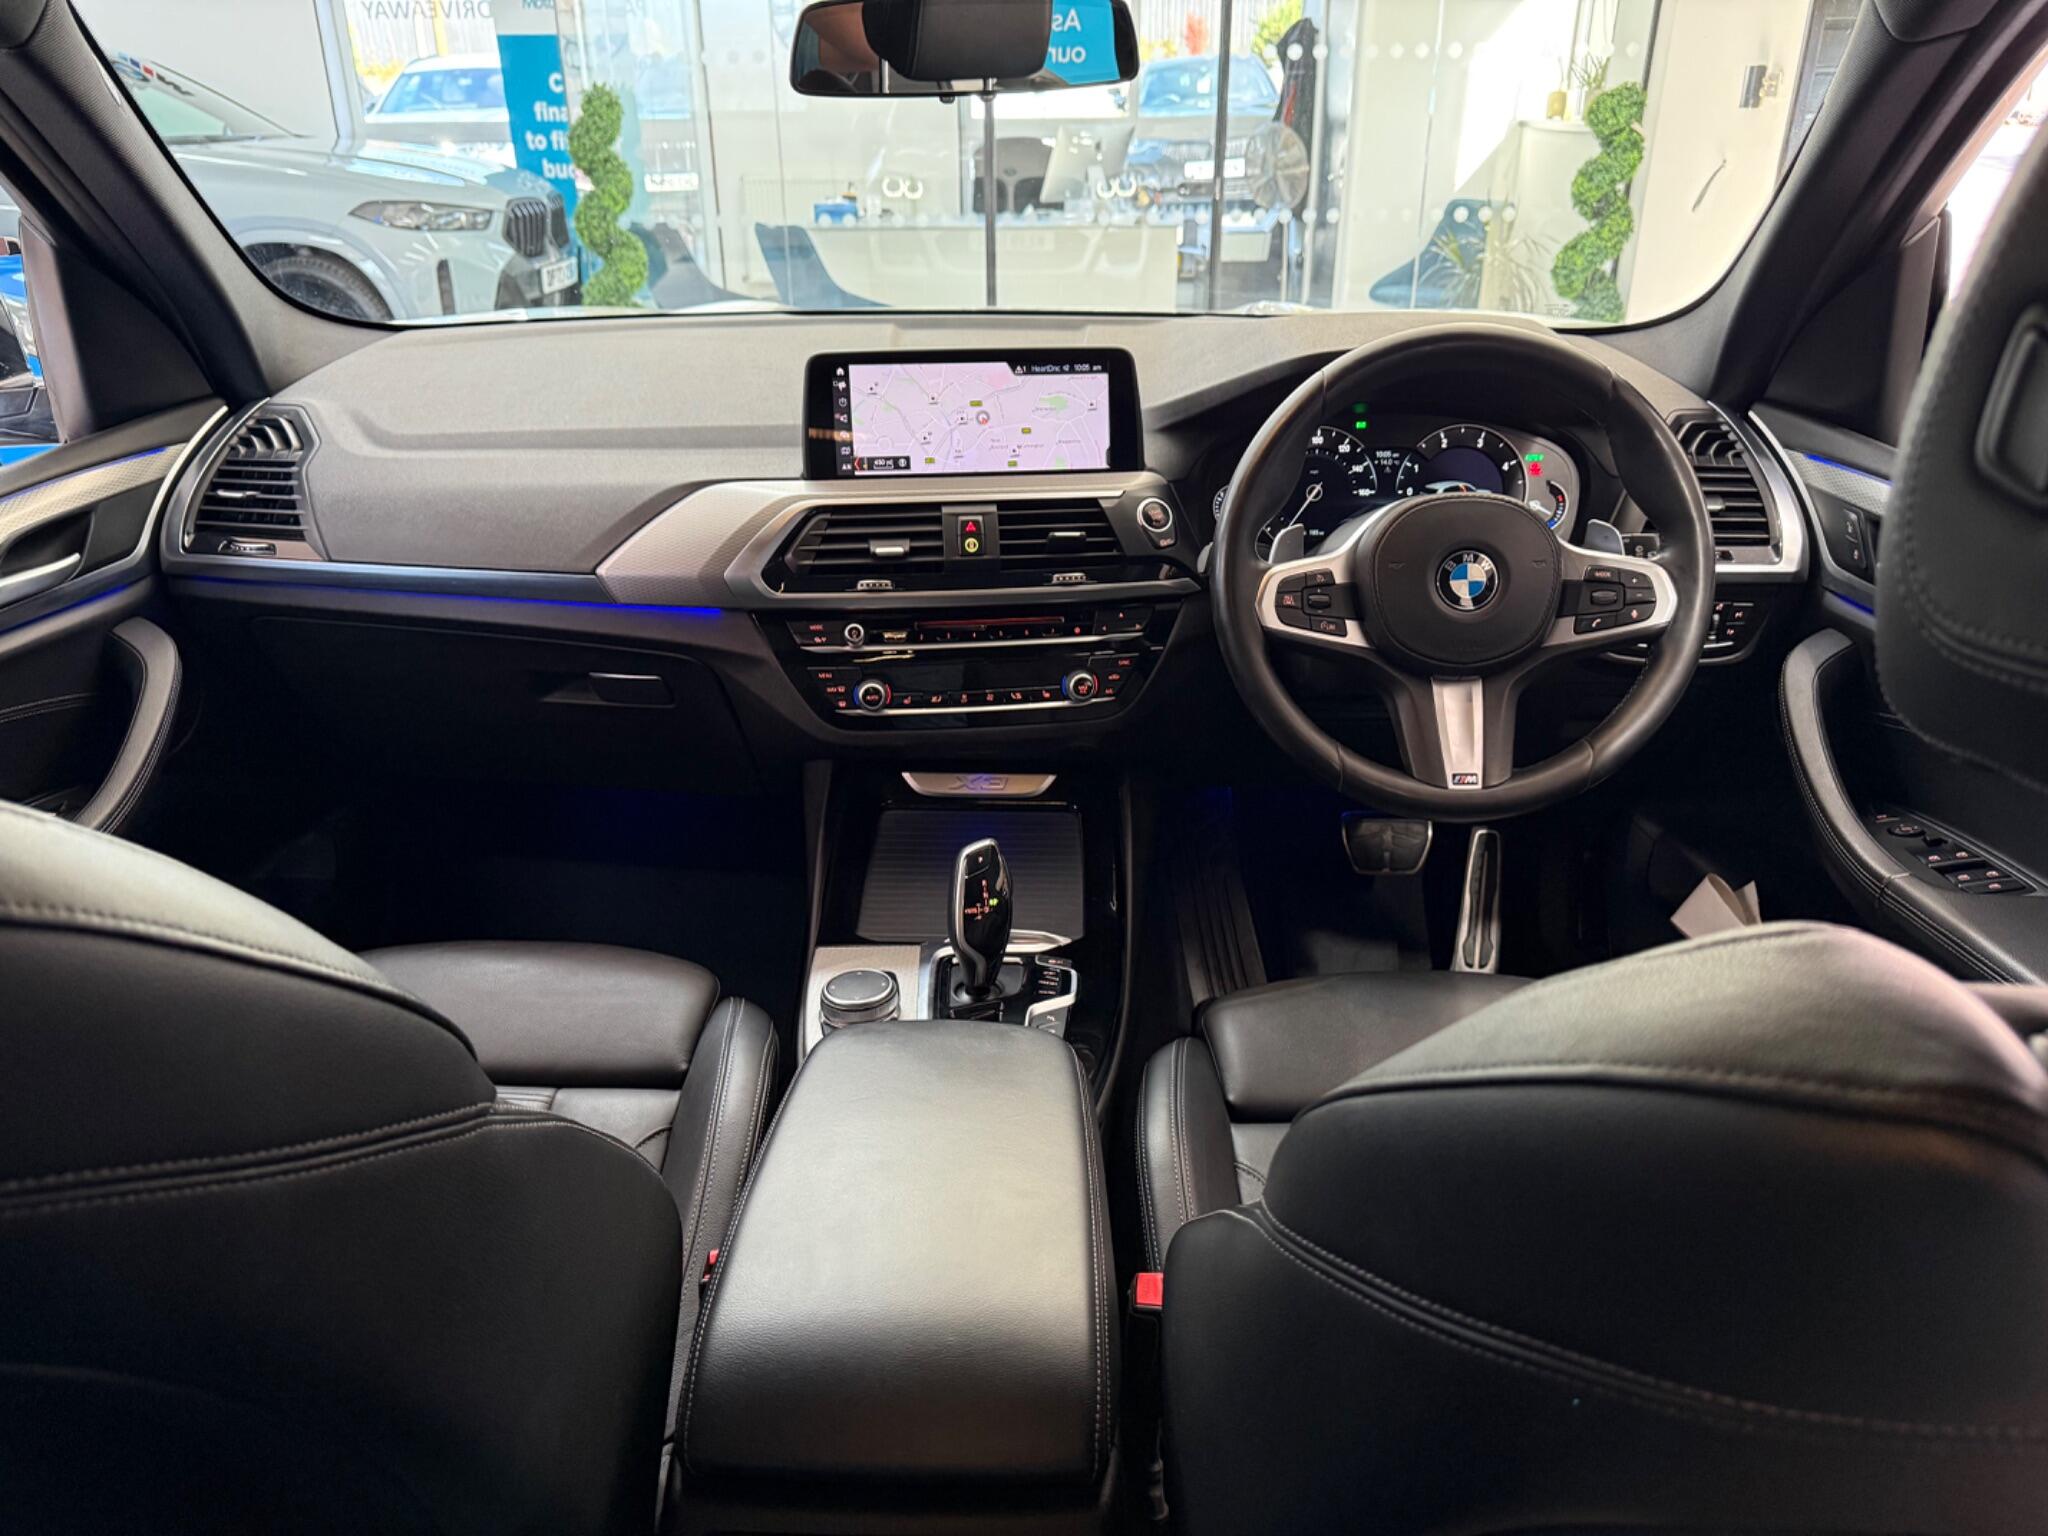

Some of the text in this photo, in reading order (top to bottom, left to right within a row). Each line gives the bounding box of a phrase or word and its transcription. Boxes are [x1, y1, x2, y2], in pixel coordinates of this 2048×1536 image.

[525, 130, 548, 151] to
[1441, 438, 1448, 448] 2
[1476, 438, 1484, 449] 3
[1502, 461, 1510, 472] 4
[948, 775, 1009, 791] X3
